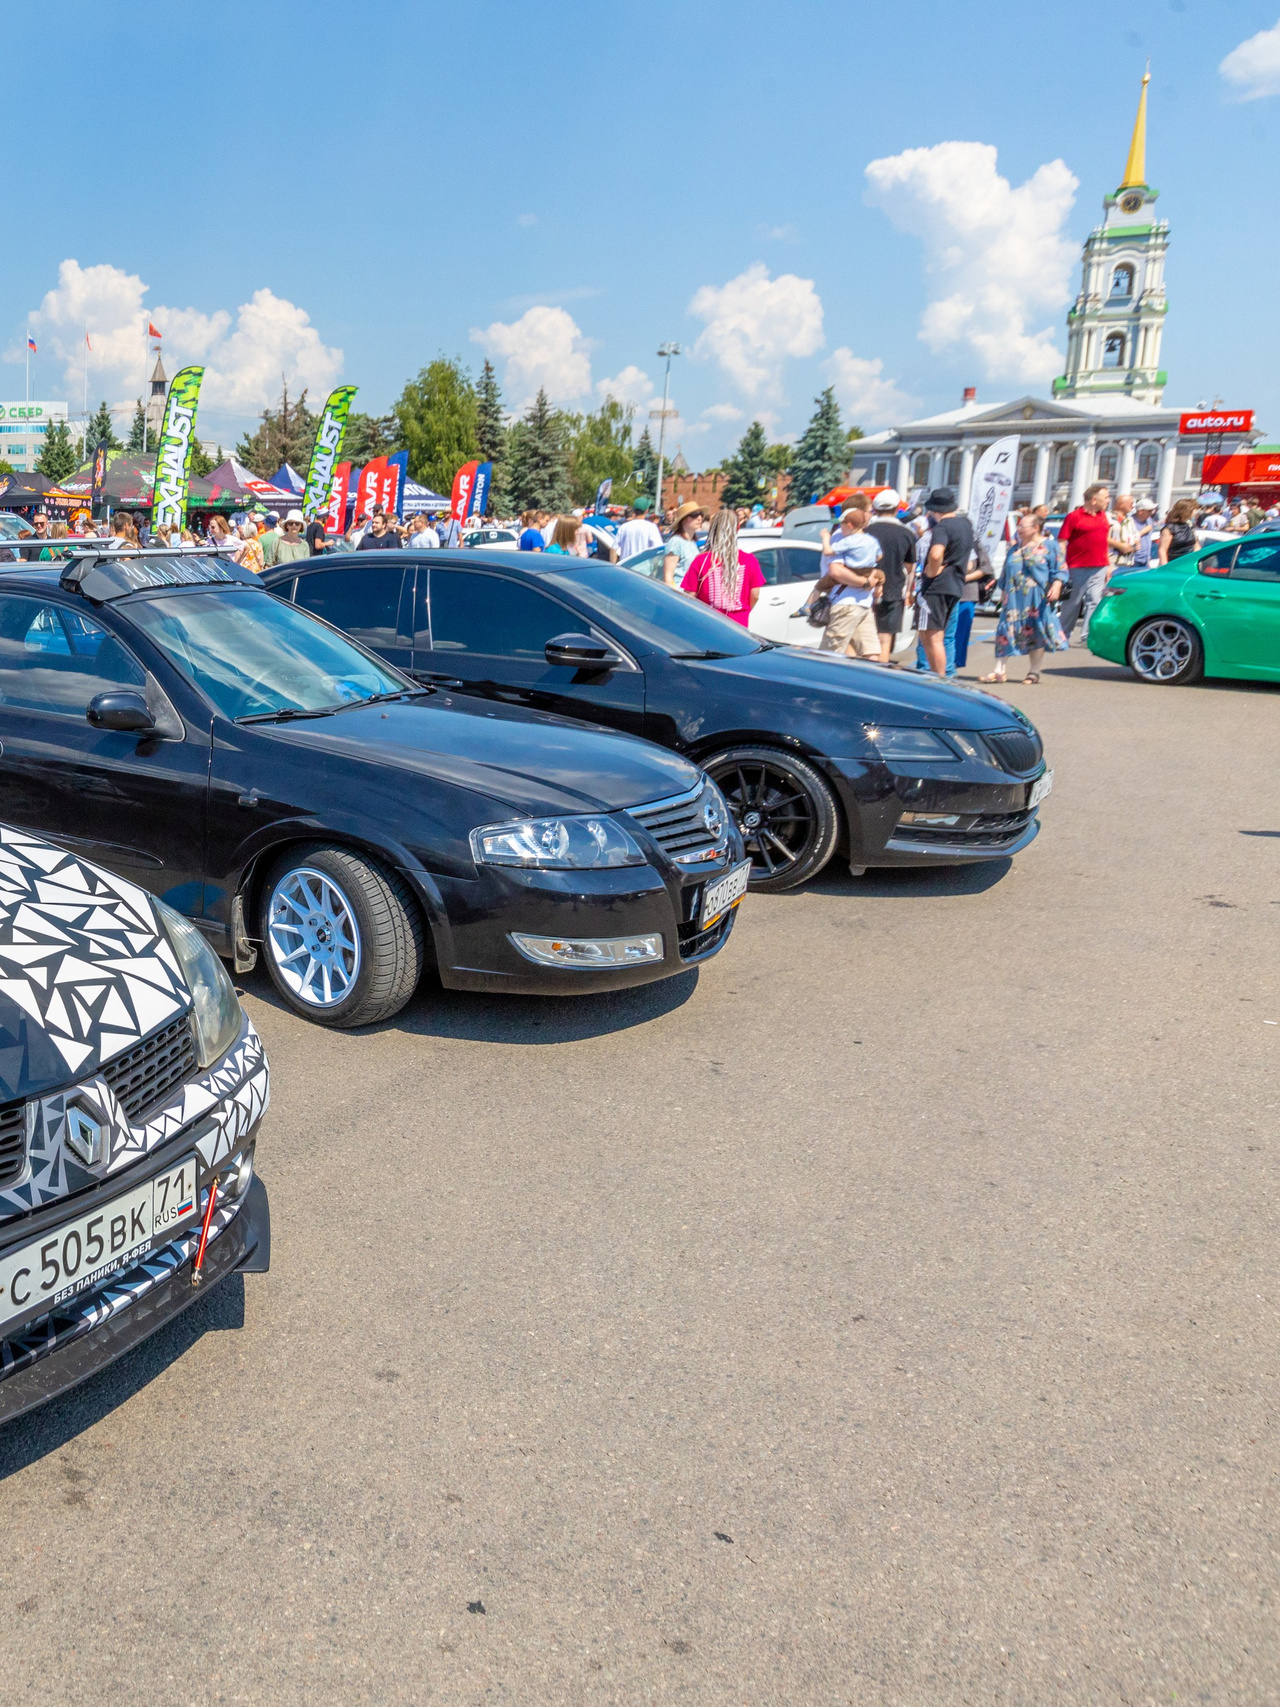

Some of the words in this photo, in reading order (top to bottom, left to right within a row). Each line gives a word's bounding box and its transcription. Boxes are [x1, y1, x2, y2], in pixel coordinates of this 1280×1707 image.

[9, 406, 43, 418] СБЕР
[1186, 415, 1245, 429] auto.ru
[156, 397, 194, 530] EXHAUST
[327, 476, 344, 533] LAVR
[364, 471, 379, 520] AVR
[157, 1167, 186, 1213] 71
[154, 1206, 178, 1229] RUS
[53, 1285, 74, 1305] БЕЗ
[76, 1259, 121, 1288] ПАНИКИ,
[121, 1240, 152, 1264] Я-ФЕЯ
